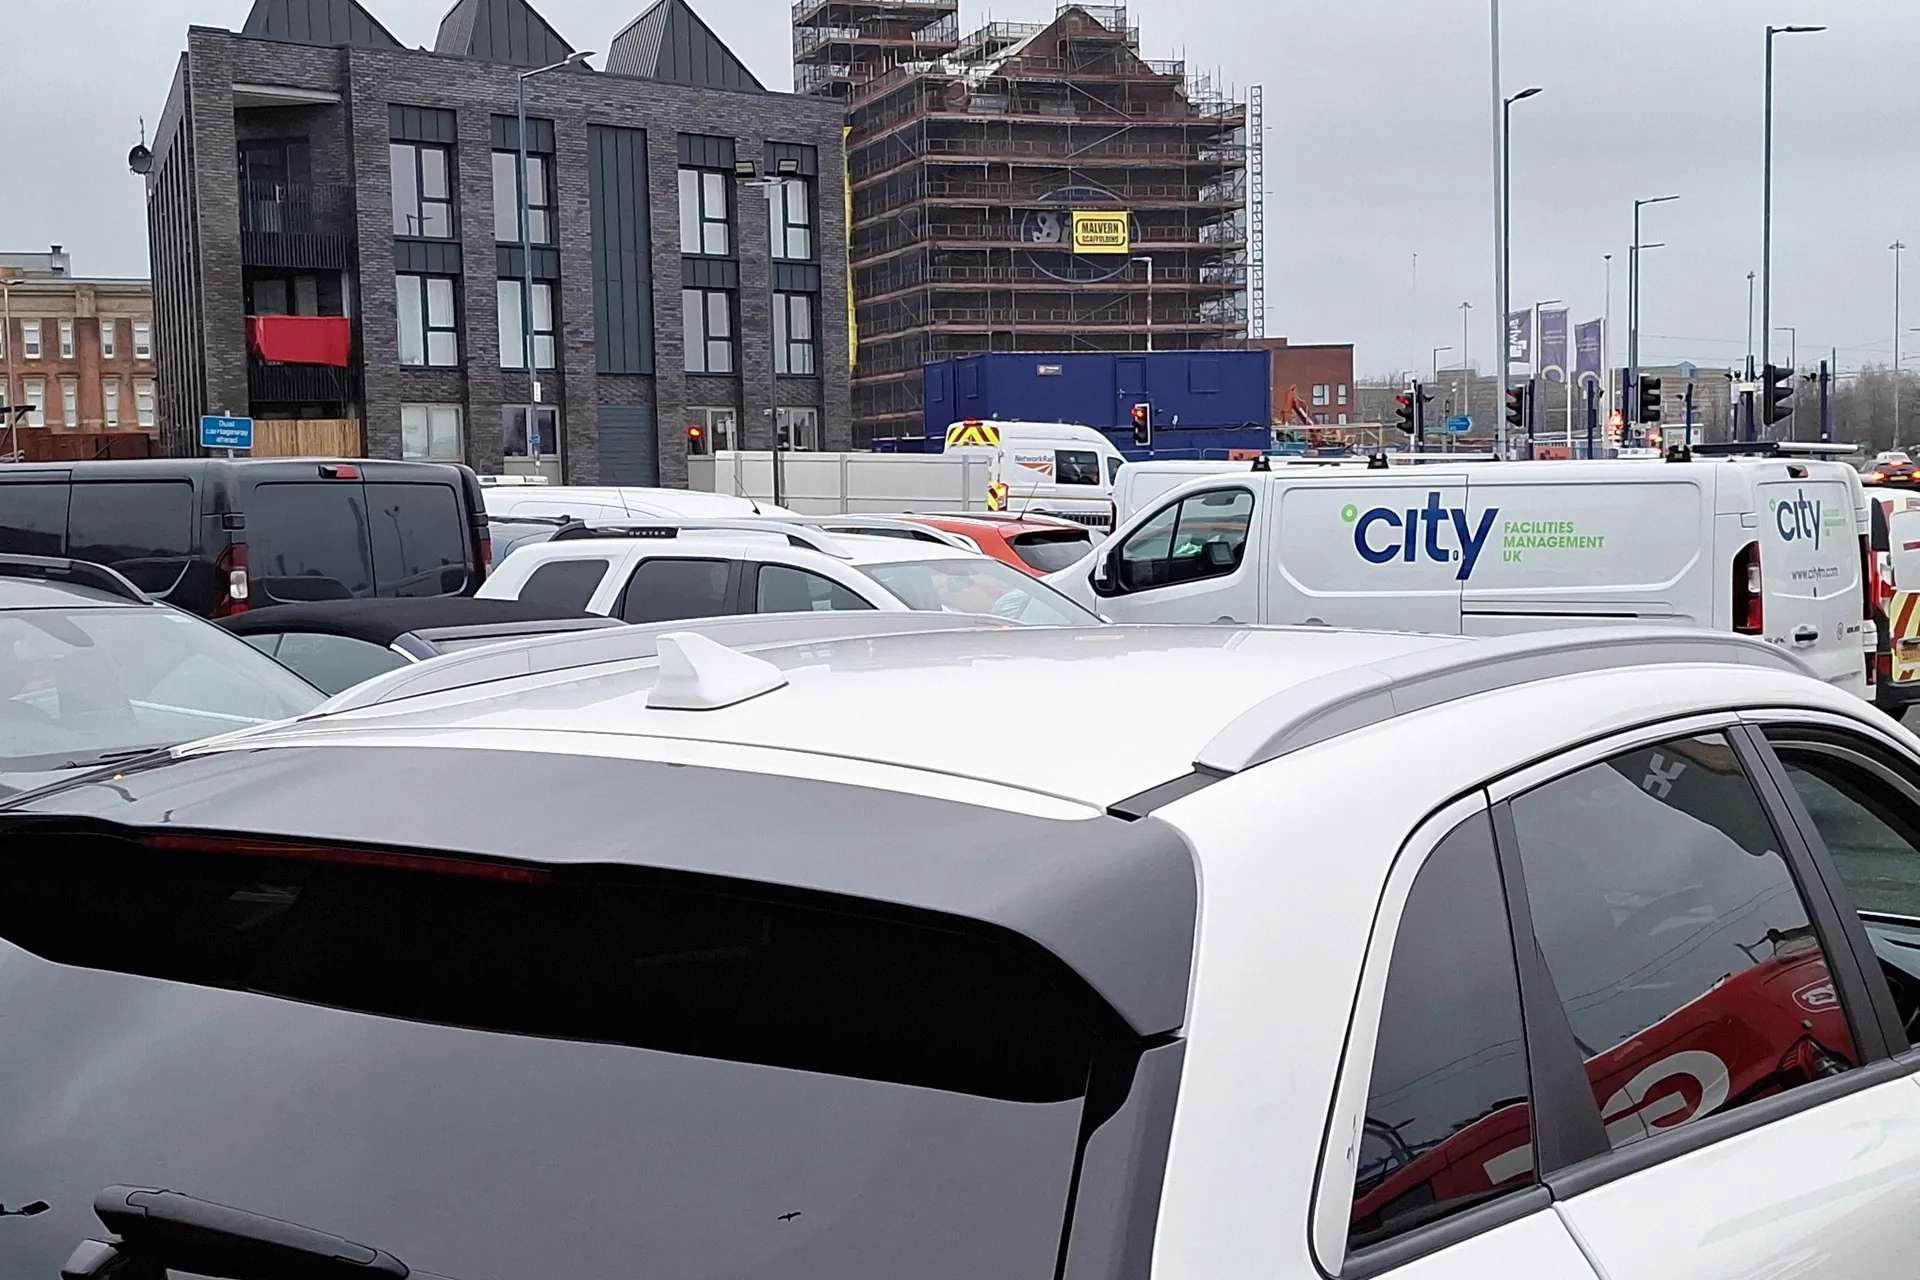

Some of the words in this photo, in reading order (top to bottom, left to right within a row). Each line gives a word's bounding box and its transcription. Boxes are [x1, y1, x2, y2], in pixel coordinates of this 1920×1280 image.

[1081, 222, 1119, 234] MALVERN
[1776, 488, 1821, 551] city
[1503, 521, 1575, 534] FACILITIES
[1354, 491, 1500, 581] city
[1503, 535, 1605, 549] MANAGEMENT
[1503, 550, 1522, 563] UK
